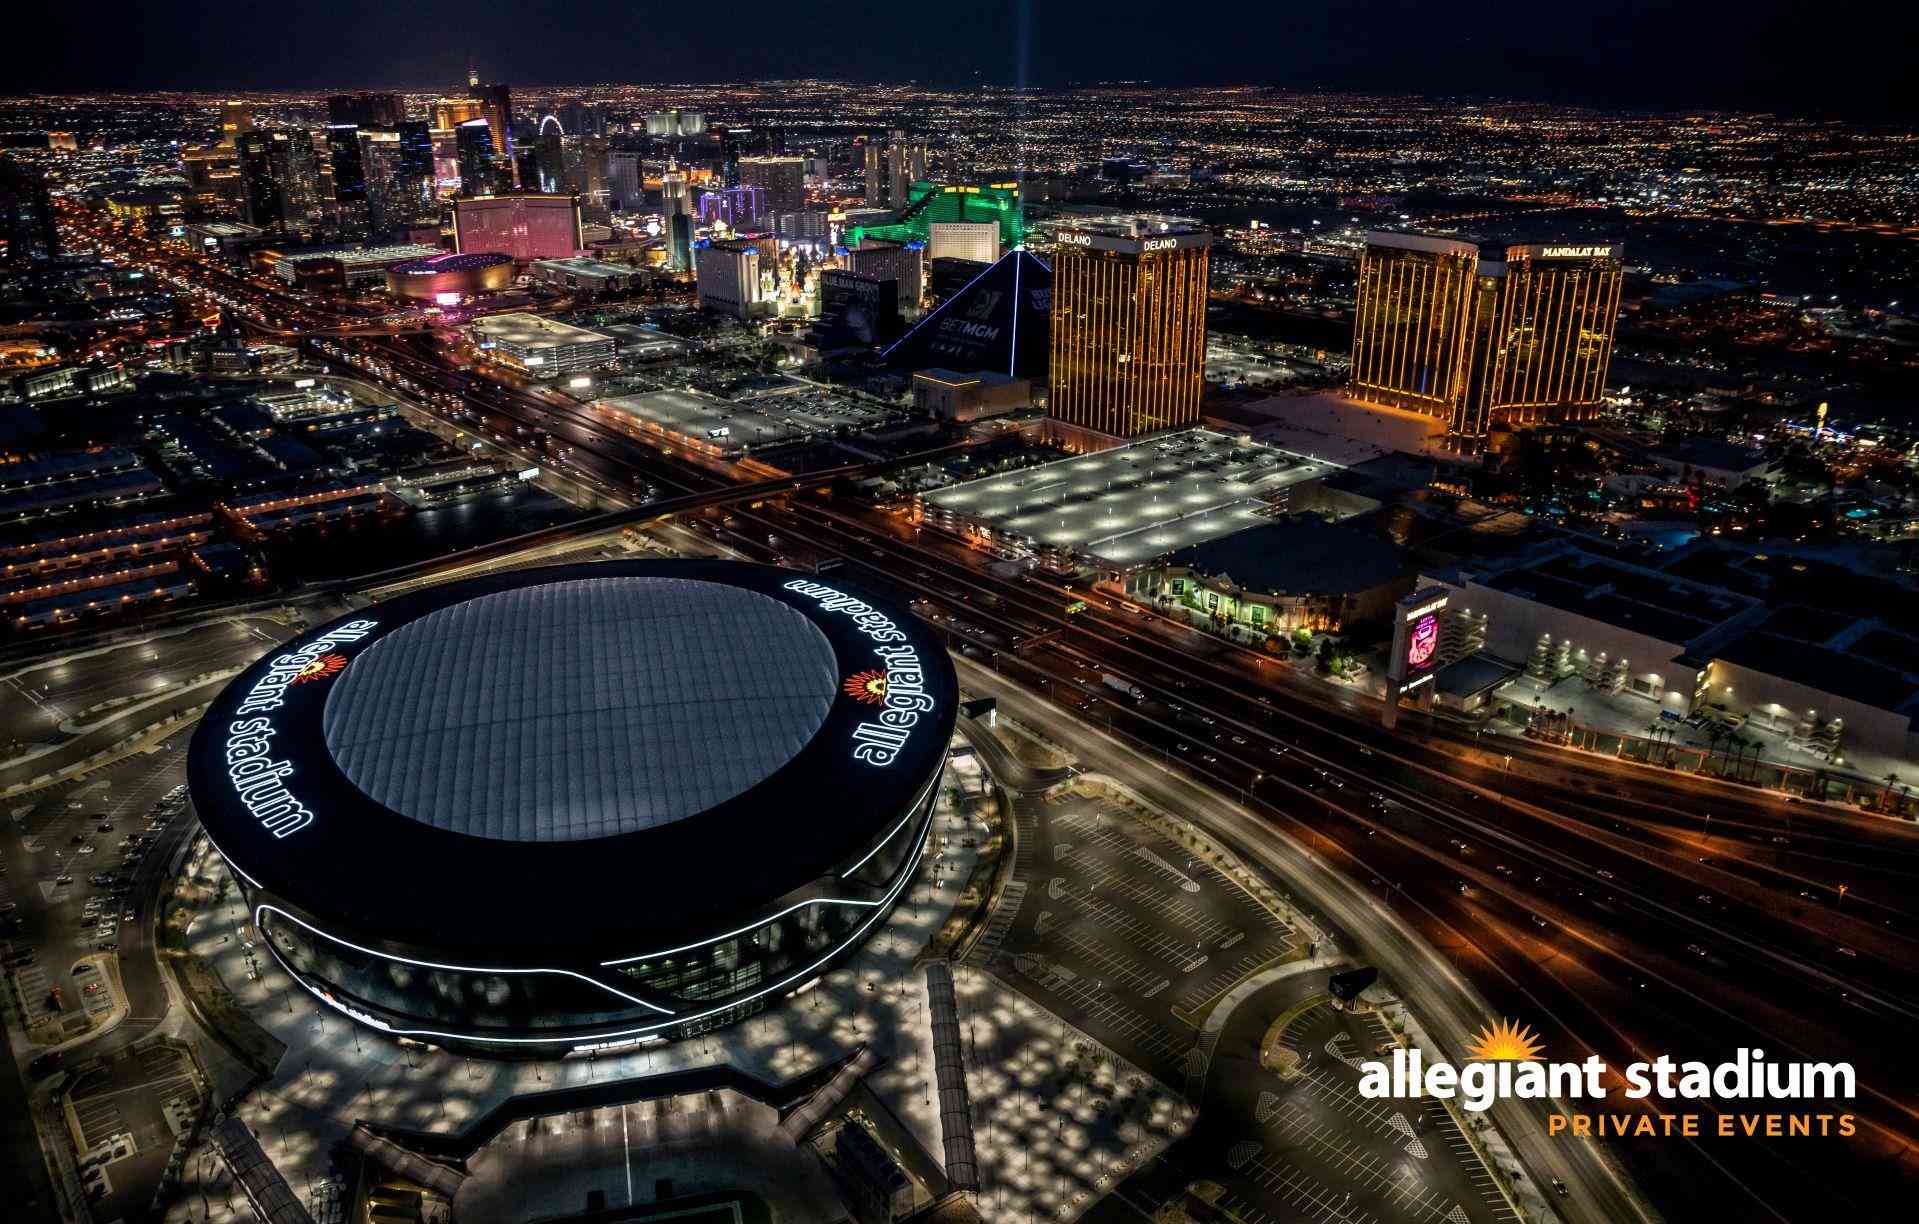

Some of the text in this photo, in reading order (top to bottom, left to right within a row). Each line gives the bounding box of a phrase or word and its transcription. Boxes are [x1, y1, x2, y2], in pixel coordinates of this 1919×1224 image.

[1058, 232, 1091, 246] DELANO
[1144, 238, 1177, 251] DELANO
[1542, 247, 1612, 257] MANDALAY BAY
[783, 579, 935, 767] allegiant stadium
[226, 618, 378, 839] allegiant stadium
